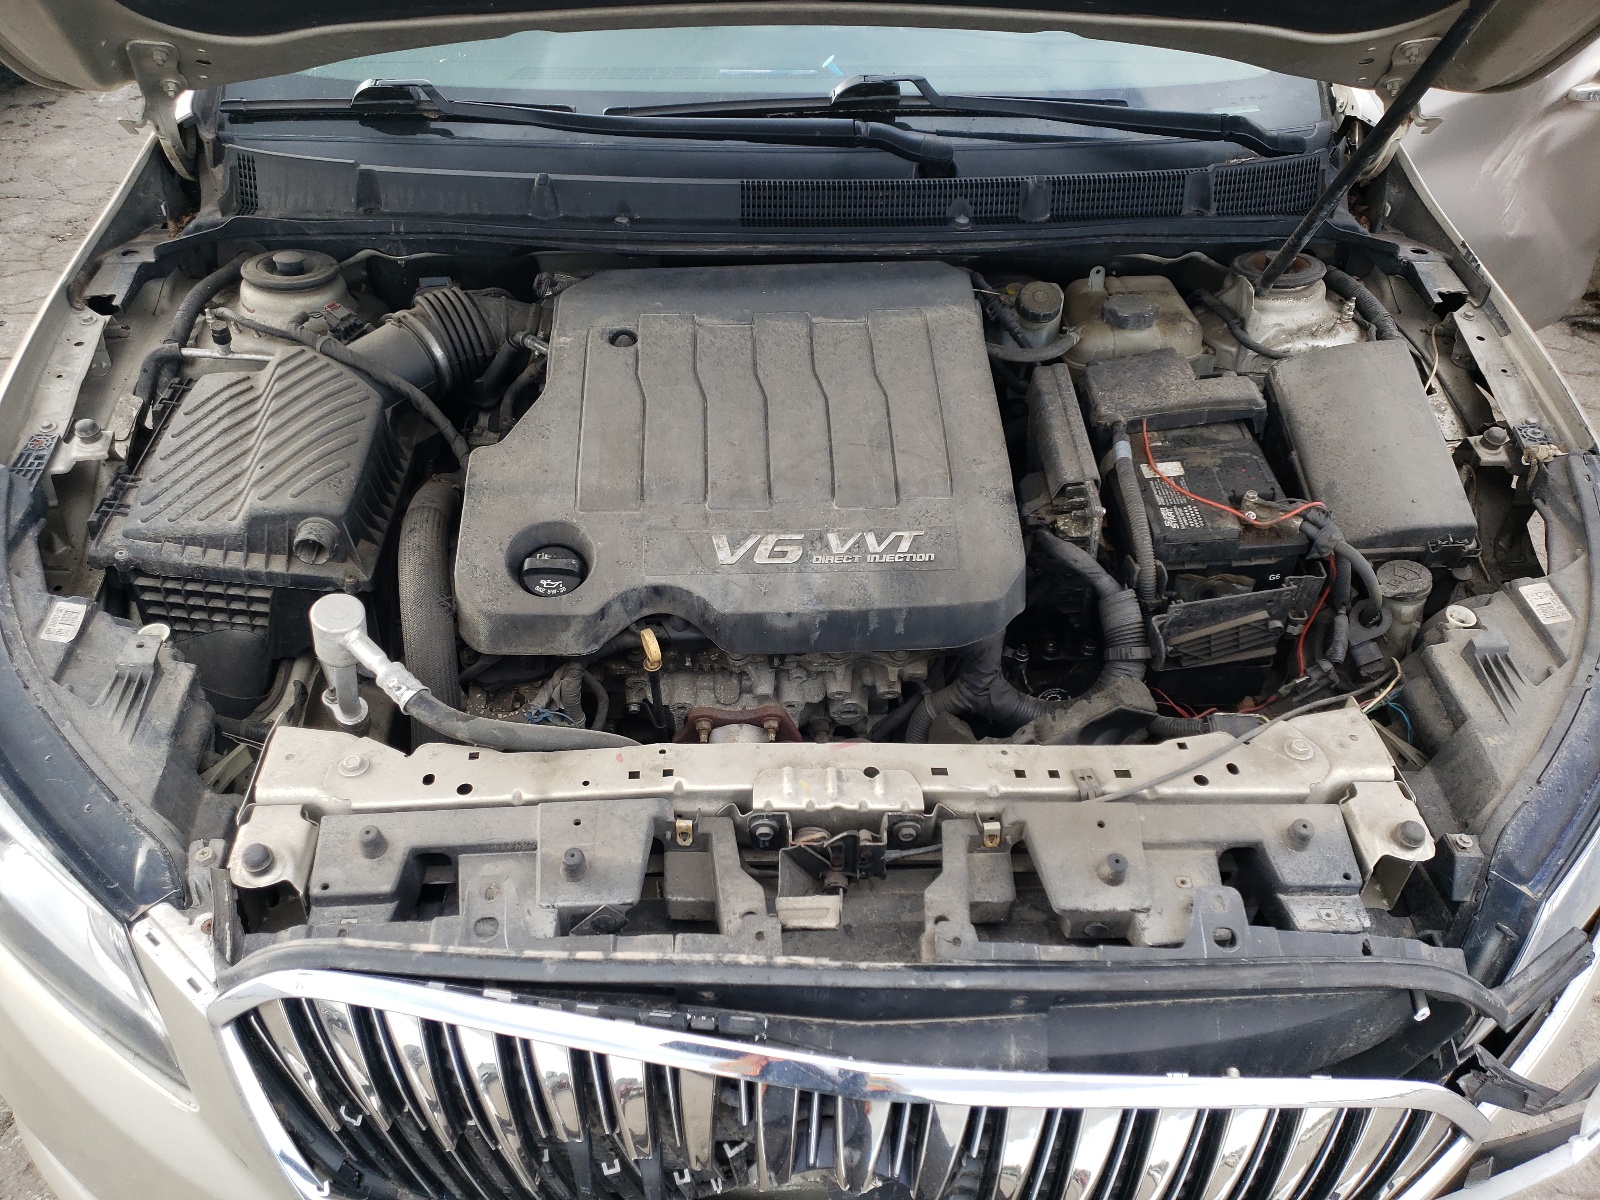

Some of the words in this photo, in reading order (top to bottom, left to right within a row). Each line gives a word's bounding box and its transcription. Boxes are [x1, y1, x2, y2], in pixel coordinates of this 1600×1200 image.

[711, 533, 805, 565] V6
[826, 530, 925, 554] VVT
[812, 554, 862, 564] DIRECT
[866, 553, 935, 563] INJECTION
[1268, 573, 1281, 581] G6
